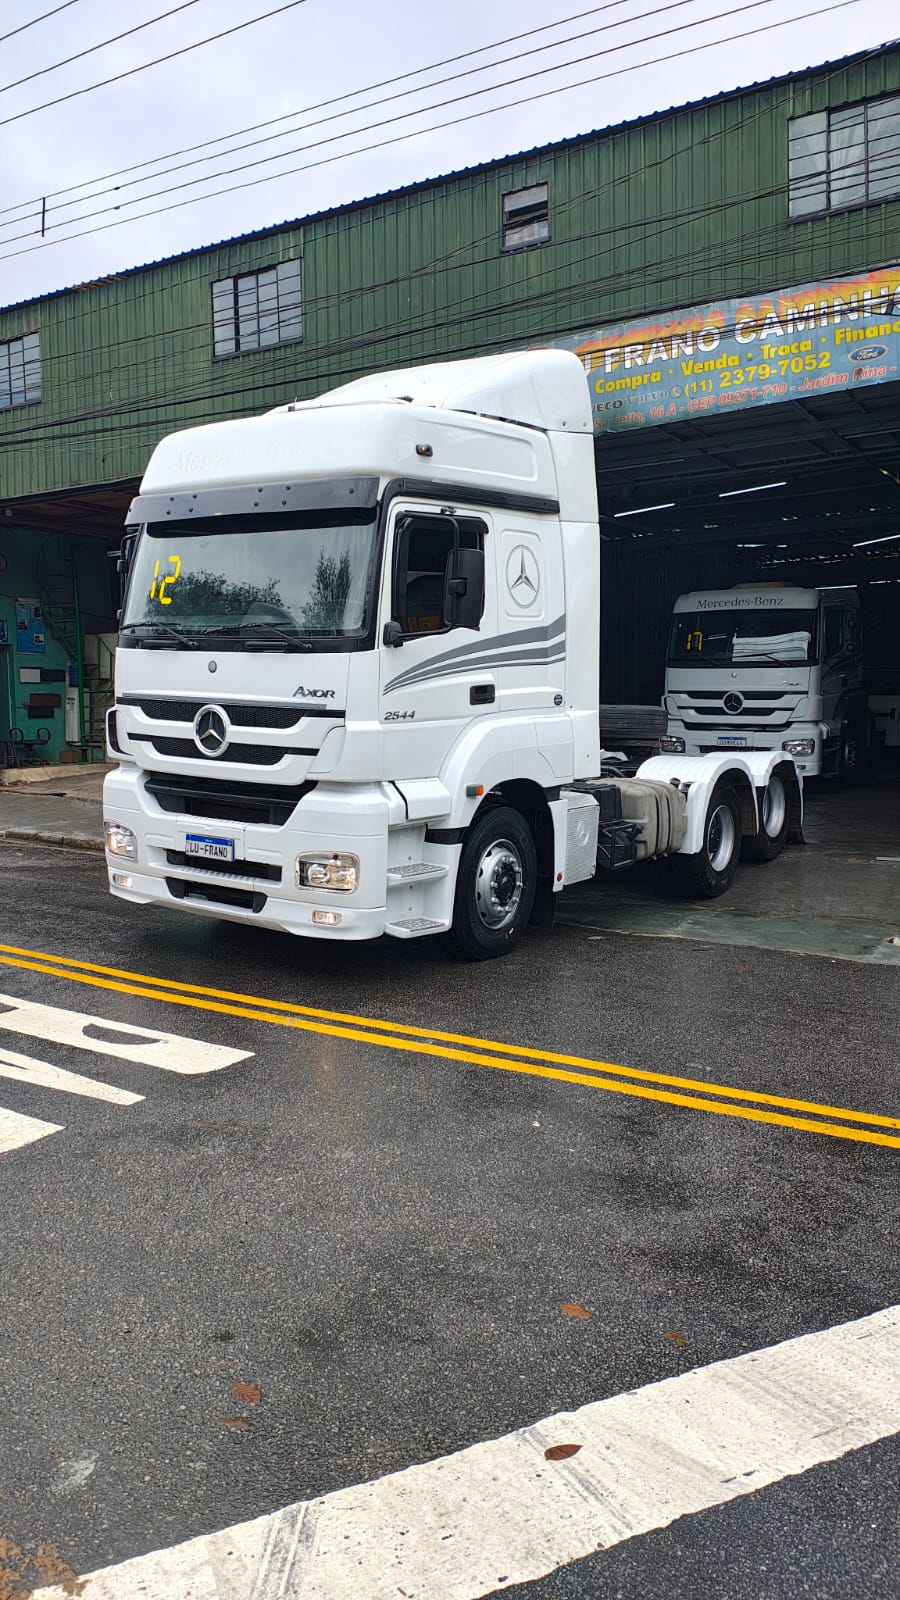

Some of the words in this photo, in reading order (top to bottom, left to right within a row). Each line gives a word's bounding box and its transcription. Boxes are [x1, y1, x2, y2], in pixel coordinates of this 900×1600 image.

[595, 371, 662, 394] Compra
[681, 352, 739, 376] Venda
[760, 339, 812, 360] Troca
[604, 326, 720, 373] FRANO
[667, 402, 677, 417] A
[687, 395, 716, 412] CEP
[719, 382, 787, 406] 09271-710
[800, 372, 849, 391] Jardim
[684, 379, 713, 397] (11)
[720, 351, 831, 388] 2379-7052
[150, 554, 182, 605] 12
[696, 597, 784, 610] Mercedes-Benz
[686, 631, 703, 652] 17
[384, 710, 415, 721] 2544
